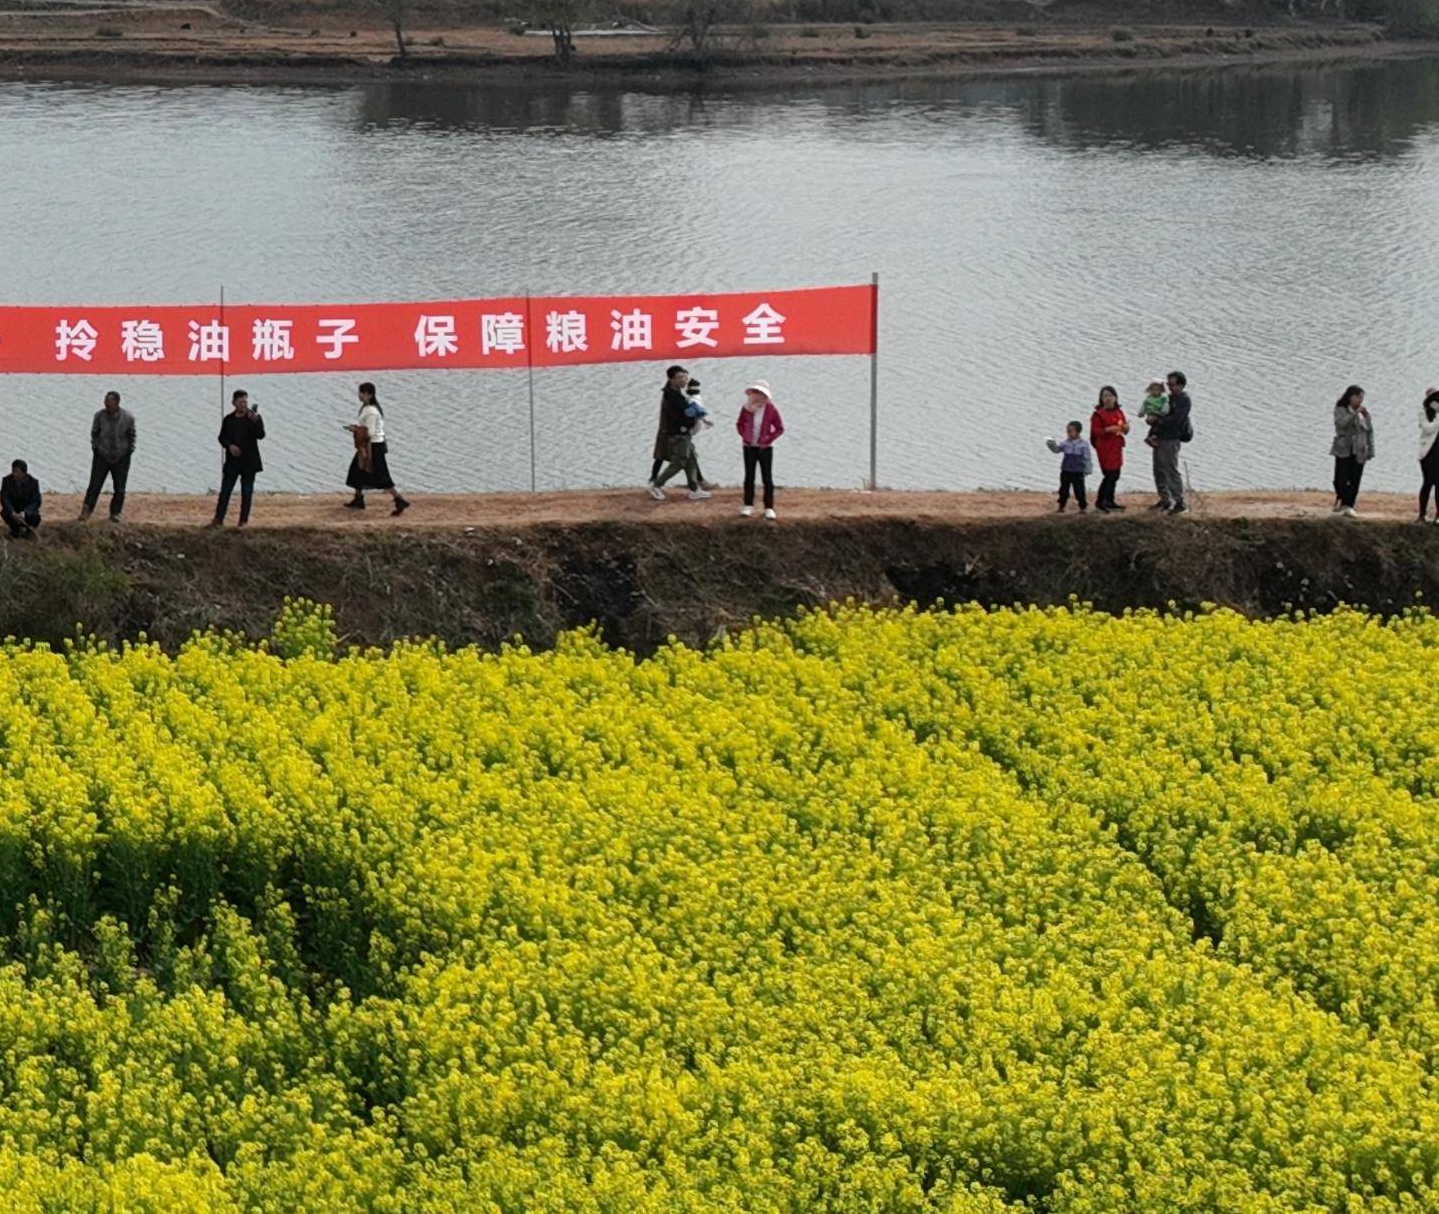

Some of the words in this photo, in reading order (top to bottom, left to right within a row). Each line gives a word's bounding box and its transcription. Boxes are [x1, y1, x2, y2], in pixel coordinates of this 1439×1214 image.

[54, 318, 359, 362] 拎稳油瓶子
[412, 302, 786, 356] 保障粮油安全
